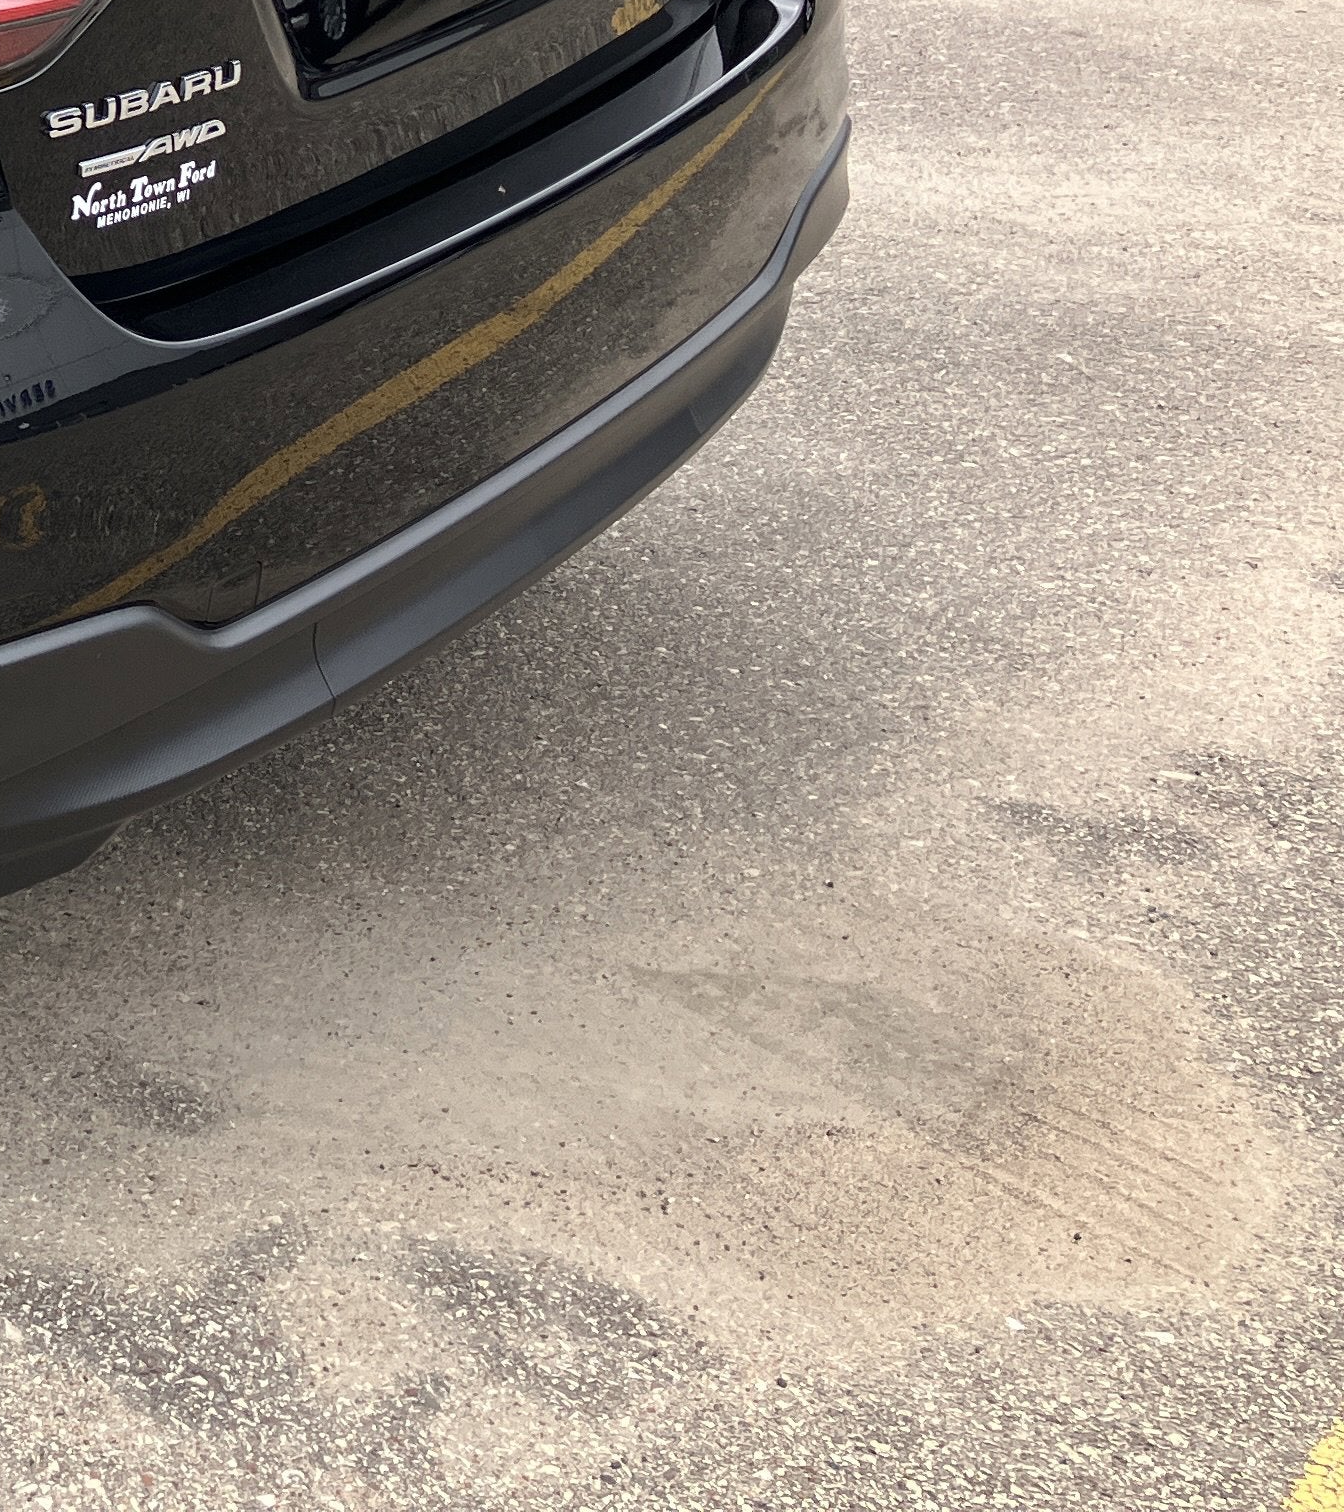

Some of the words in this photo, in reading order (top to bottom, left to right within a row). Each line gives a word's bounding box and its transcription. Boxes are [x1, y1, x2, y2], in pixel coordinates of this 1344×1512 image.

[42, 59, 241, 138] SUBARU
[138, 119, 226, 162] AWD
[71, 181, 128, 221] North
[130, 175, 176, 203] Town
[178, 159, 216, 189] Ford
[97, 196, 172, 229] MENOMONIE,
[176, 188, 192, 203] WI
